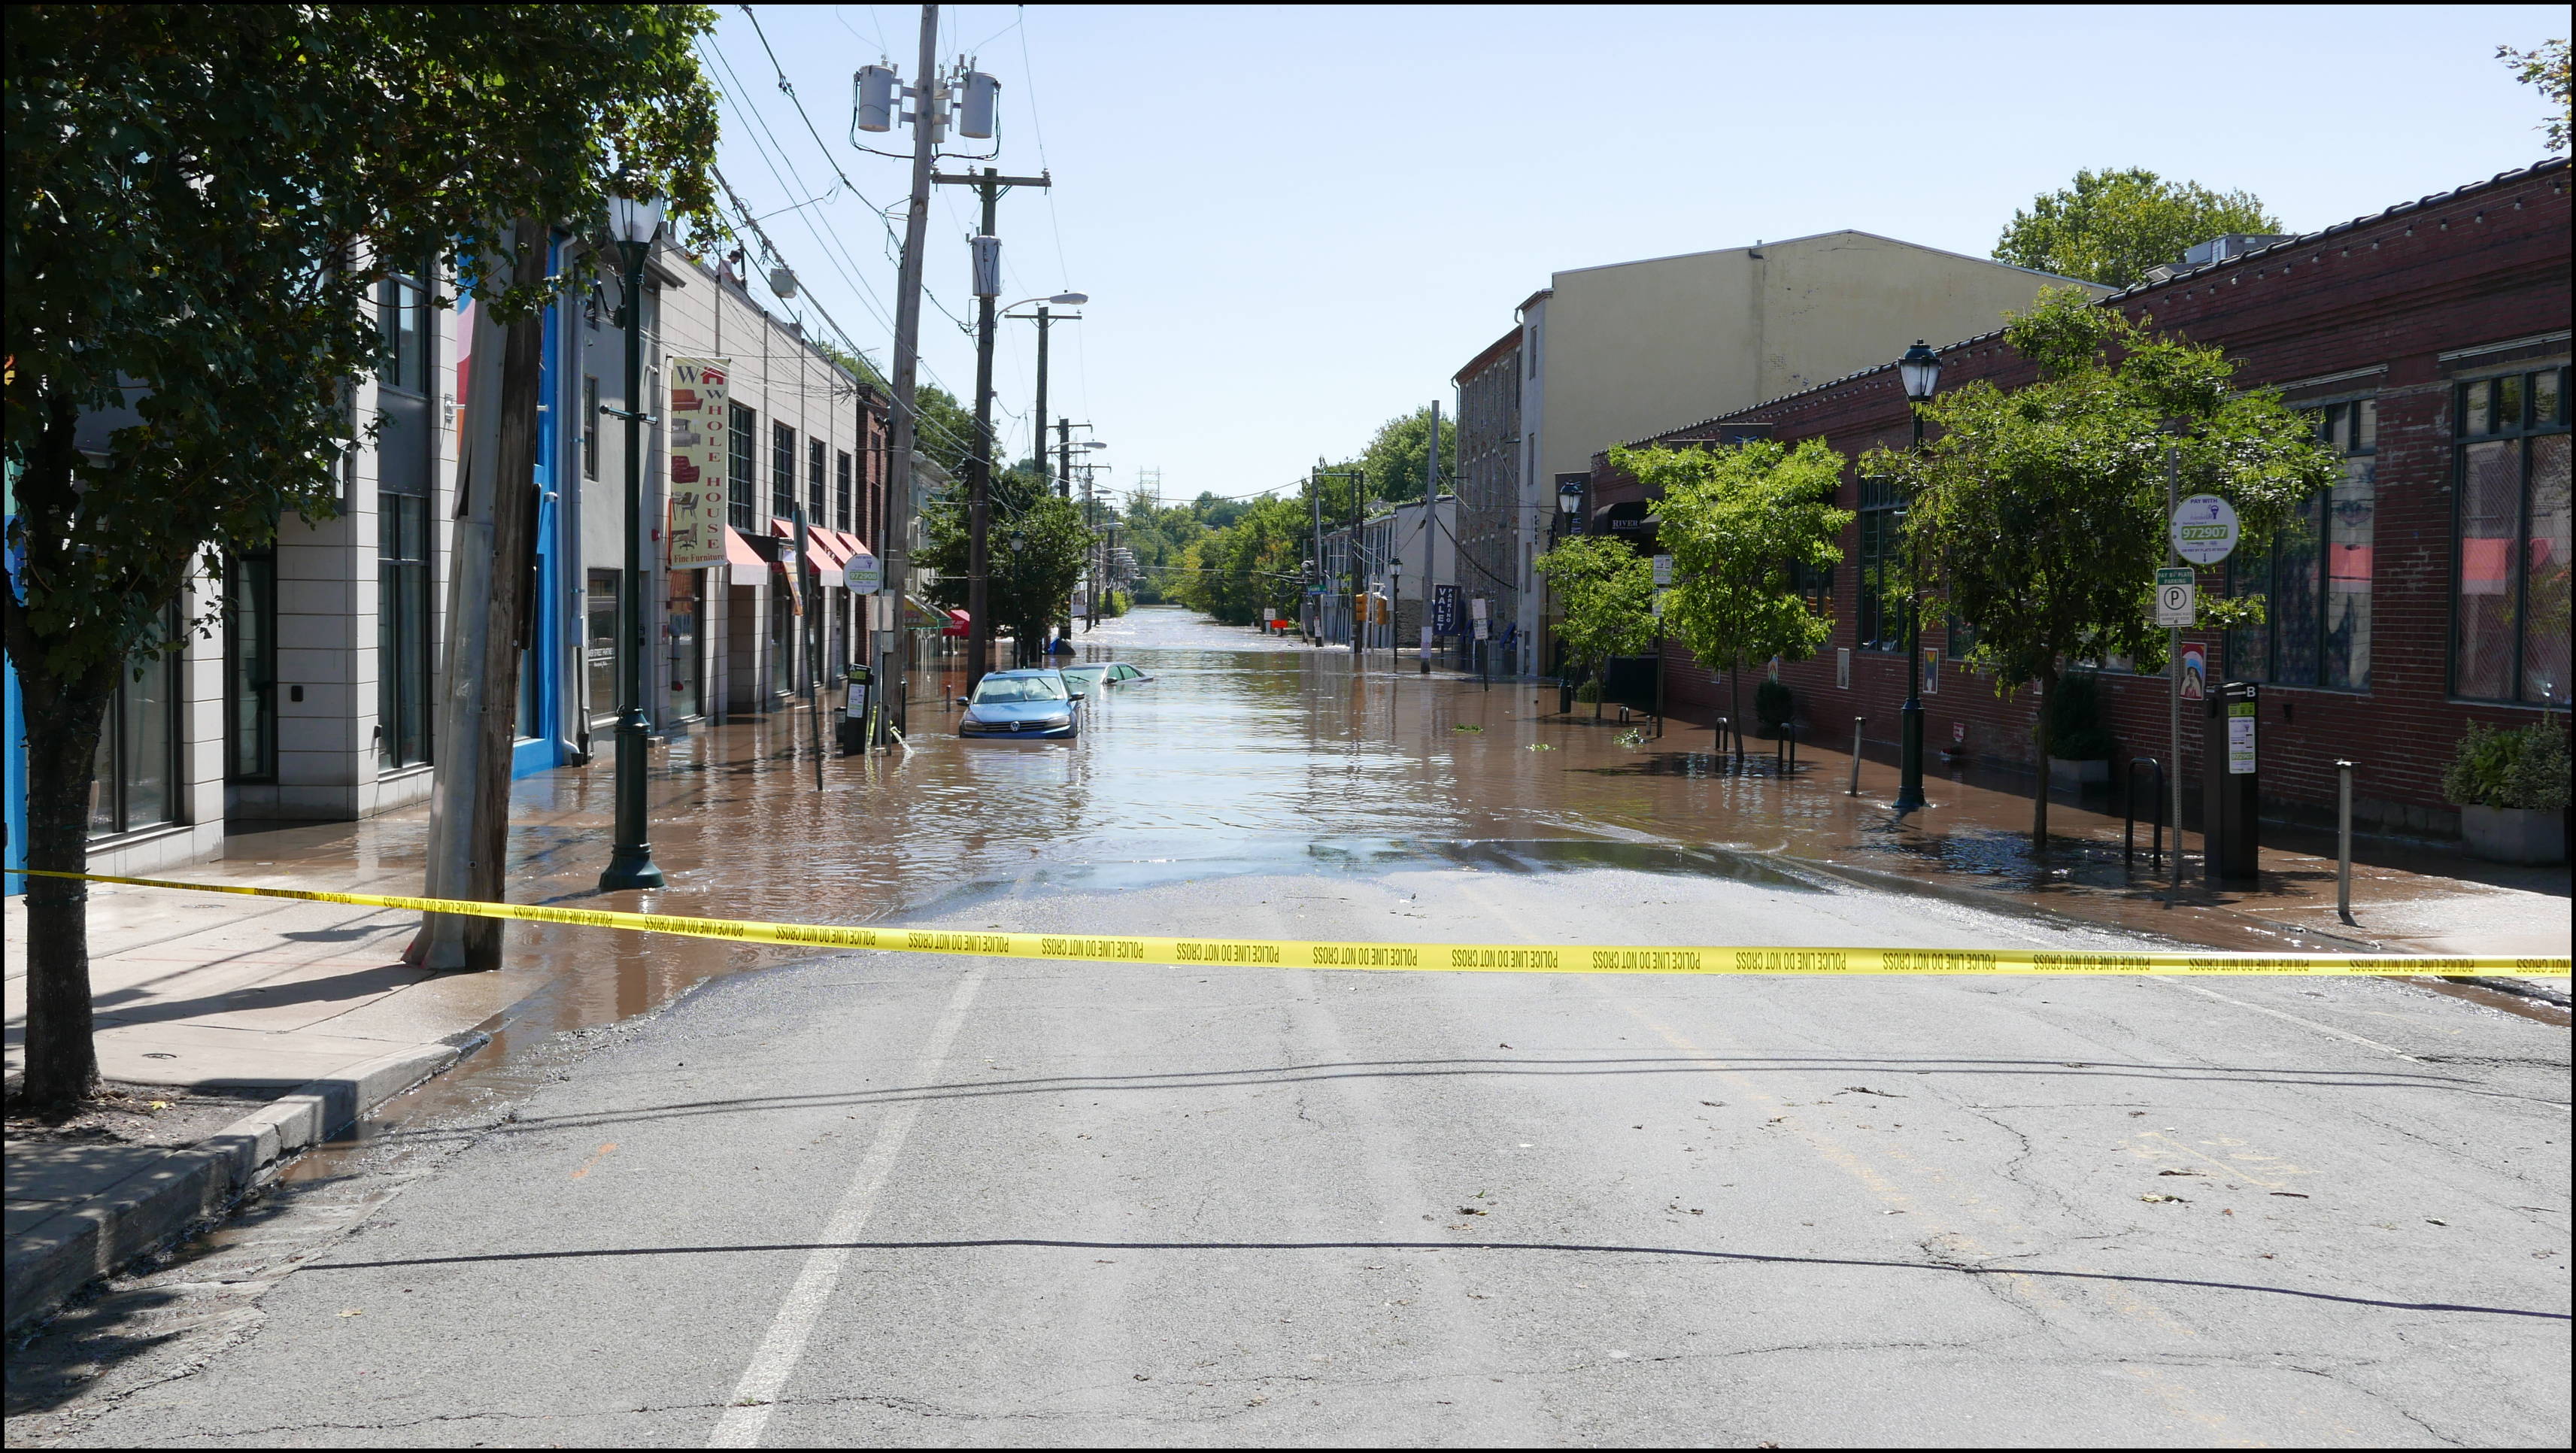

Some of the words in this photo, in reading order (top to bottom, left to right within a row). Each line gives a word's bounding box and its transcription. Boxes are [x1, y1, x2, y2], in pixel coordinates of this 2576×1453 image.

[705, 390, 727, 462] WHOLE
[705, 477, 721, 549] HOUSE
[2183, 526, 2227, 538] 972907
[674, 554, 688, 563] Fine
[691, 553, 724, 563] Furniture
[2171, 590, 2179, 605] P
[1437, 588, 1446, 631] VALET
[2247, 686, 2256, 697] B
[384, 897, 408, 911] CROSS
[411, 899, 423, 911] NOT
[426, 899, 436, 914] DO
[438, 901, 454, 914] LINE
[456, 902, 482, 915] POLICE
[514, 907, 539, 921] CROSS
[539, 909, 554, 923] NOT
[556, 910, 566, 924] DO
[568, 911, 585, 924] LINE
[586, 912, 614, 927] POLICE
[645, 917, 669, 932] CROSS
[670, 919, 686, 933] NOT
[687, 920, 698, 934] DO
[699, 921, 716, 935] LINE
[718, 923, 744, 937] POLICE
[776, 927, 801, 941] CROSS
[802, 928, 818, 942] NOT
[819, 929, 830, 943] DO
[831, 930, 848, 944] LINE
[849, 930, 876, 945] POLICE
[909, 933, 933, 949] CROSS
[935, 933, 950, 950] NOT
[952, 934, 962, 951] DO
[964, 935, 981, 951] LINE
[983, 936, 1009, 953] POLICE
[1042, 939, 1067, 956] CROSS
[1069, 939, 1084, 956] NOT
[1085, 940, 1096, 957] DO
[1098, 940, 1115, 957] LINE
[1117, 941, 1144, 958] POLICE
[1177, 943, 1202, 960] CROSS
[1203, 944, 1219, 961] NOT
[1220, 944, 1232, 962] DO
[1233, 945, 1250, 962] LINE
[1252, 945, 1279, 963] POLICE
[1313, 947, 1339, 964] CROSS
[1340, 947, 1358, 965] NOT
[1358, 948, 1369, 965] DO
[1370, 948, 1388, 966] LINE
[1389, 948, 1418, 966] POLICE
[1452, 949, 1478, 967] CROSS
[1479, 950, 1497, 967] NOT
[1497, 950, 1508, 968] DO
[1509, 951, 1528, 968] LINE
[1529, 950, 1559, 968] POLICE
[1593, 951, 1619, 969] CROSS
[1620, 951, 1637, 969] NOT
[1638, 951, 1650, 969] DO
[1652, 951, 1670, 969] LINE
[1672, 951, 1701, 969] POLICE
[1736, 952, 1763, 970] CROSS
[1765, 952, 1781, 970] NOT
[1783, 952, 1795, 970] DO
[1798, 952, 1815, 970] LINE
[1818, 952, 1846, 970] POLICE
[1883, 953, 1910, 970] CROSS
[1913, 953, 1929, 970] NOT
[1930, 953, 1943, 970] DO
[1946, 953, 1964, 970] LINE
[1967, 953, 1996, 970] POLICE
[2034, 954, 2062, 970] CROSS
[2063, 954, 2081, 970] NOT
[2083, 955, 2095, 971] DO
[2098, 955, 2117, 970] LINE
[2120, 956, 2150, 971] POLICE
[2189, 958, 2218, 972] CROSS
[2221, 958, 2238, 971] NOT
[2241, 957, 2253, 972] DO
[2256, 958, 2275, 972] LINE
[2278, 958, 2310, 972] POLICE
[2350, 959, 2380, 972] CROSS
[2383, 959, 2401, 972] NOT
[2403, 958, 2416, 972] DO
[2419, 958, 2439, 972] LINE
[2442, 958, 2475, 972] POLICE
[2517, 959, 2548, 972] CROSS
[2550, 959, 2569, 973] NOT
